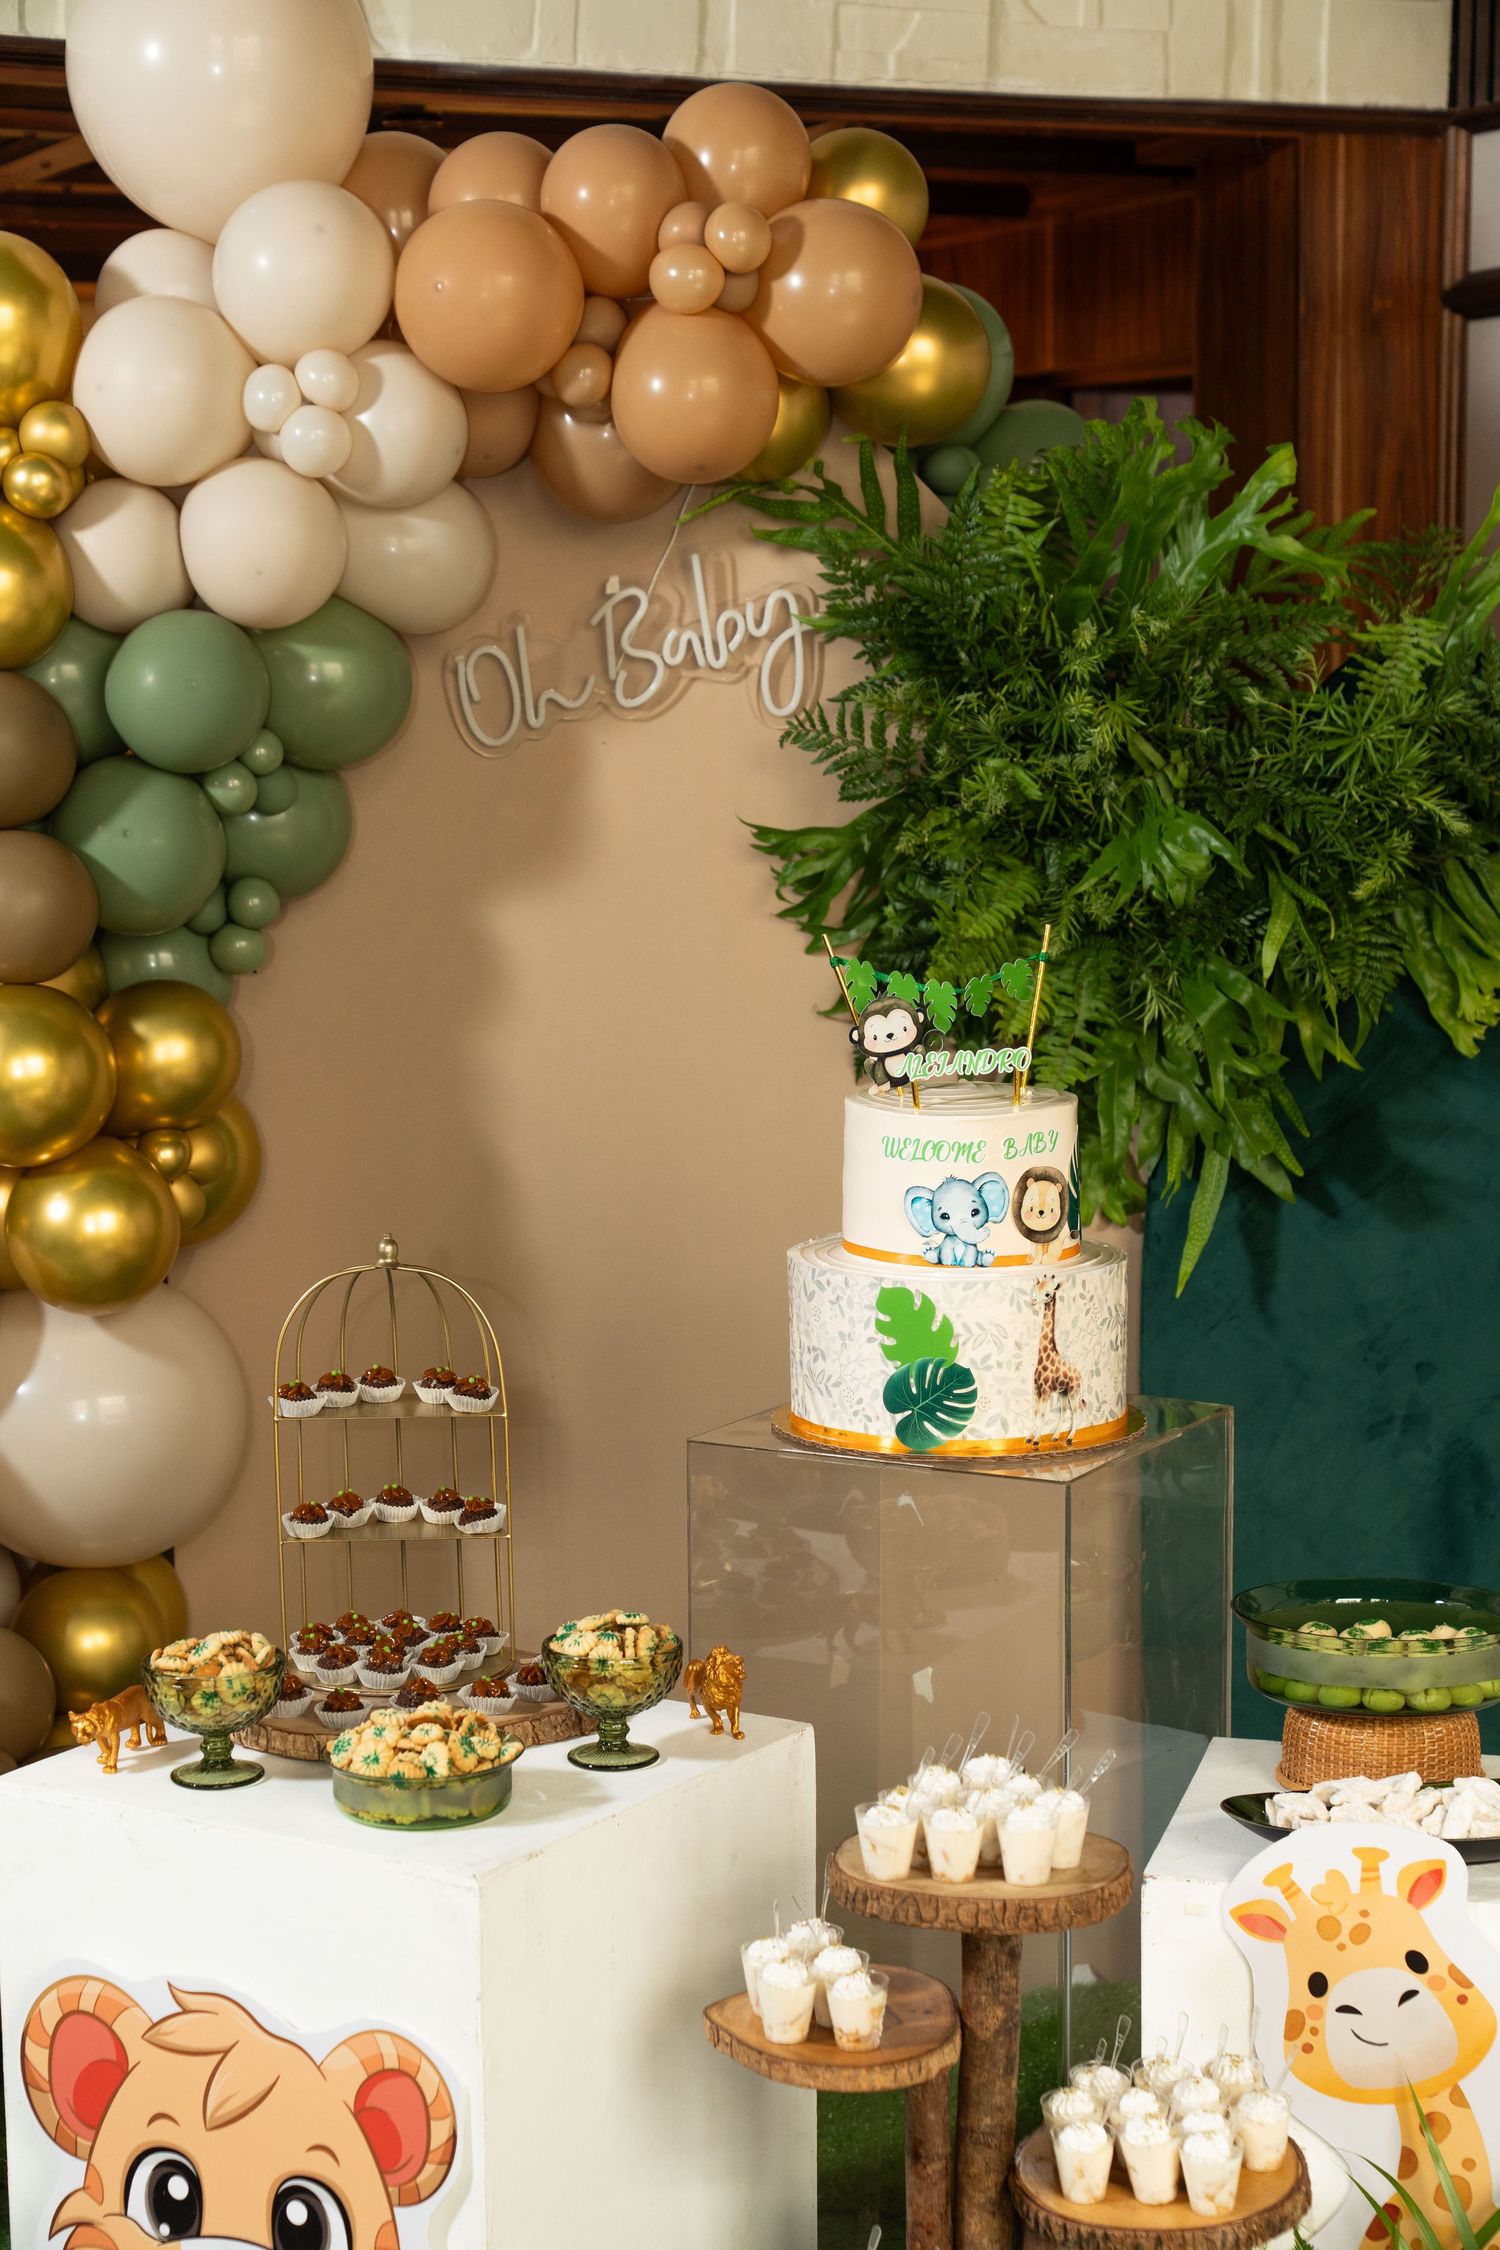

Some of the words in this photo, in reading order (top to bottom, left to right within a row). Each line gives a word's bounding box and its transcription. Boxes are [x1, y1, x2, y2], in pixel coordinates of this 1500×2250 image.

[454, 623, 597, 748] Oh
[590, 553, 821, 717] Baby
[896, 1047, 1032, 1080] ALEJANDRO
[881, 1135, 987, 1164] WELCOME
[1003, 1129, 1060, 1160] BABY
